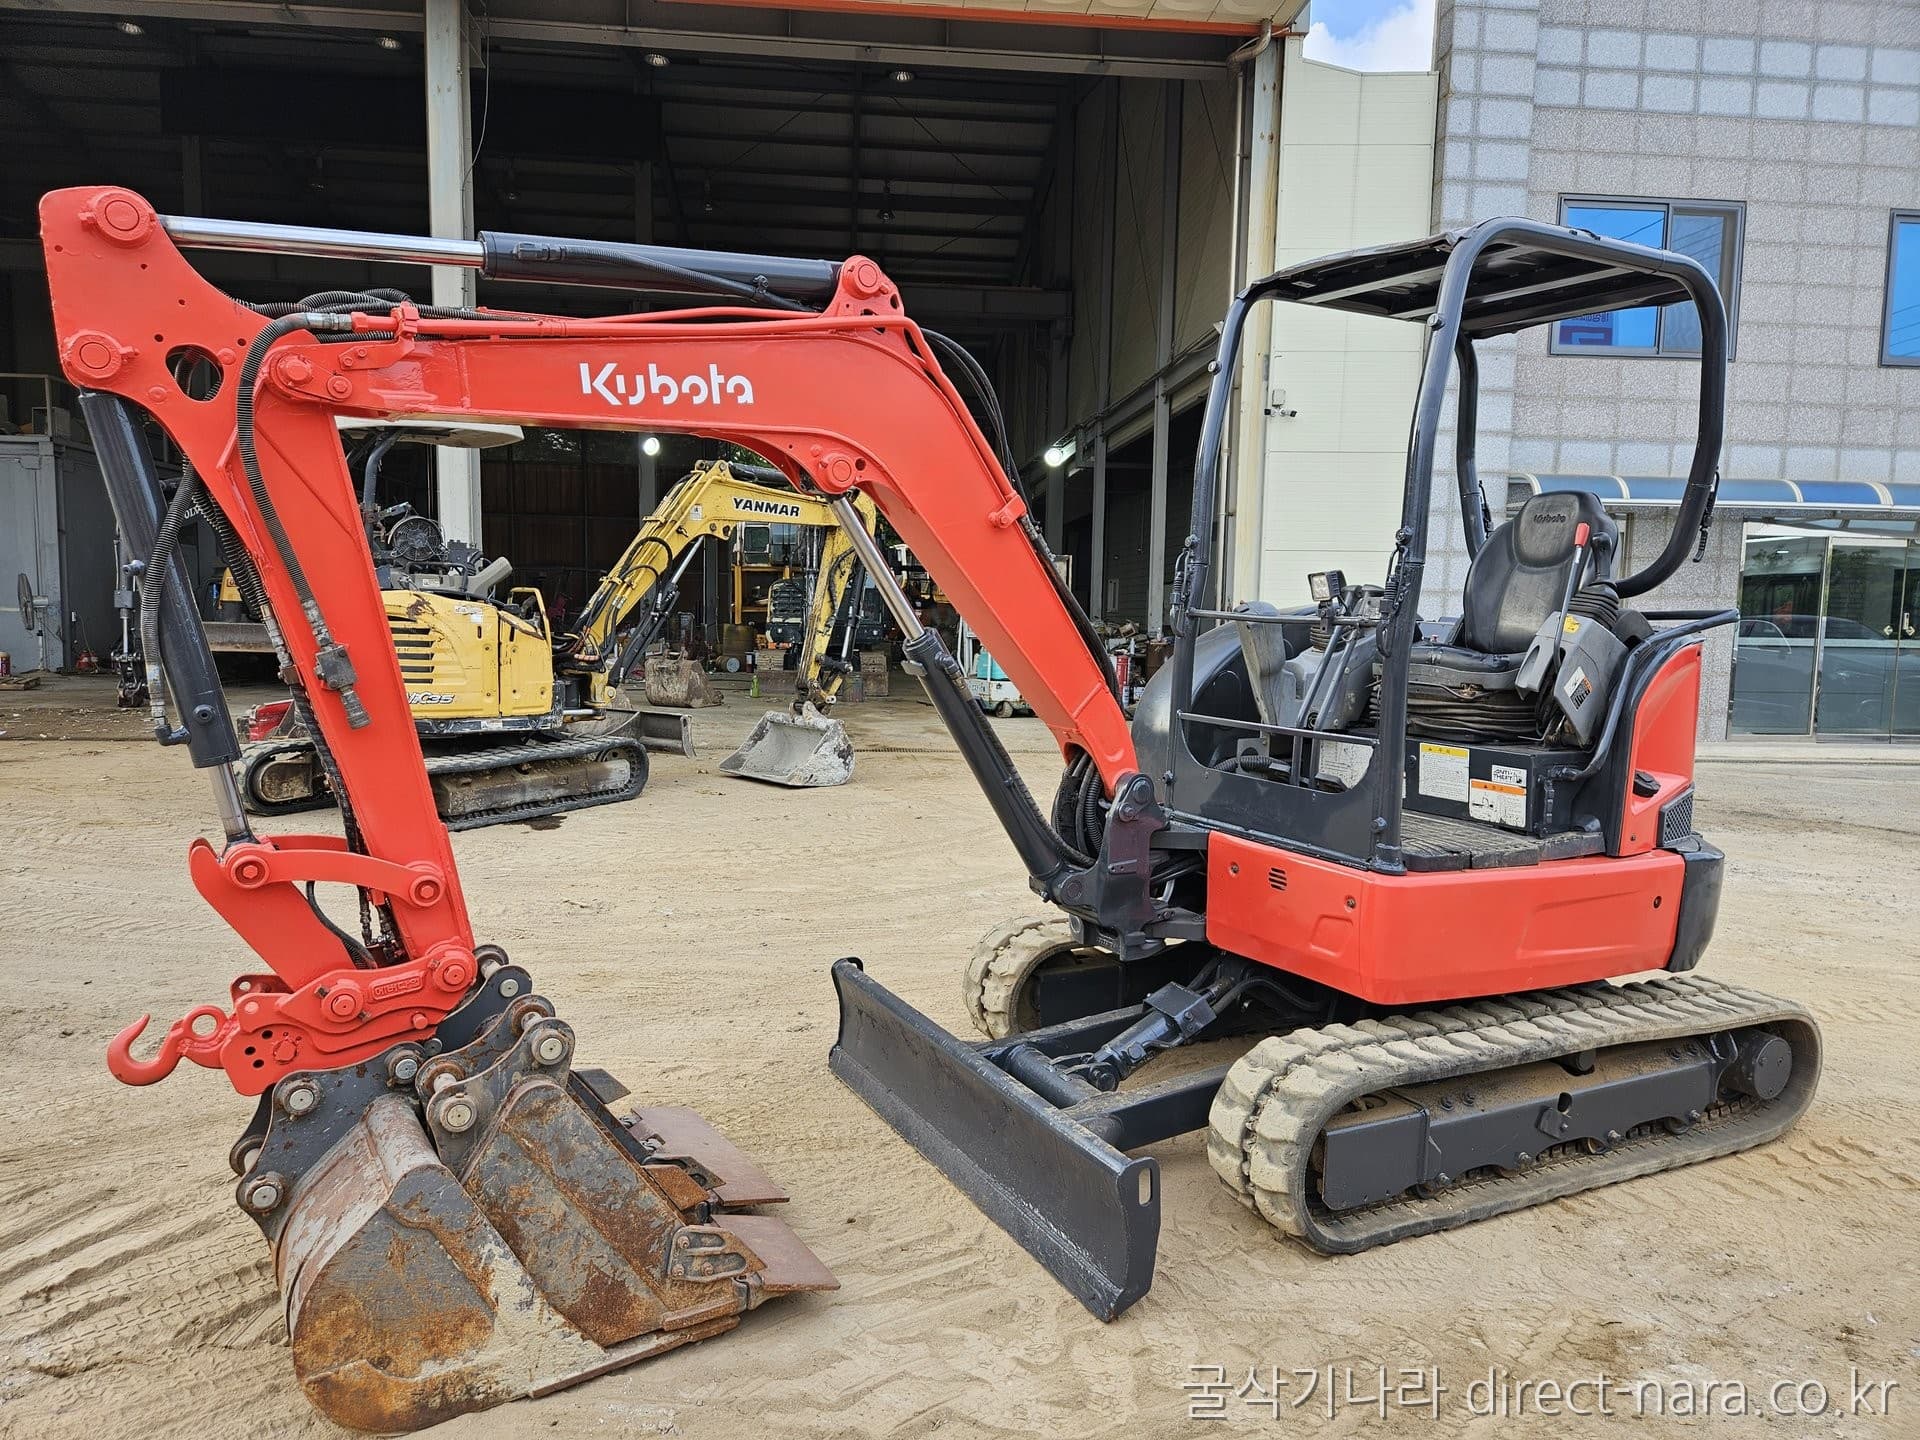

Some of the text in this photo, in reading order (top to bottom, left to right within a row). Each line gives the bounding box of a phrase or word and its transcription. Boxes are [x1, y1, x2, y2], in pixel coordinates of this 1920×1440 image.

[579, 362, 754, 405] Kubota
[733, 497, 800, 517] YANMAR
[1533, 513, 1566, 523] Kubota
